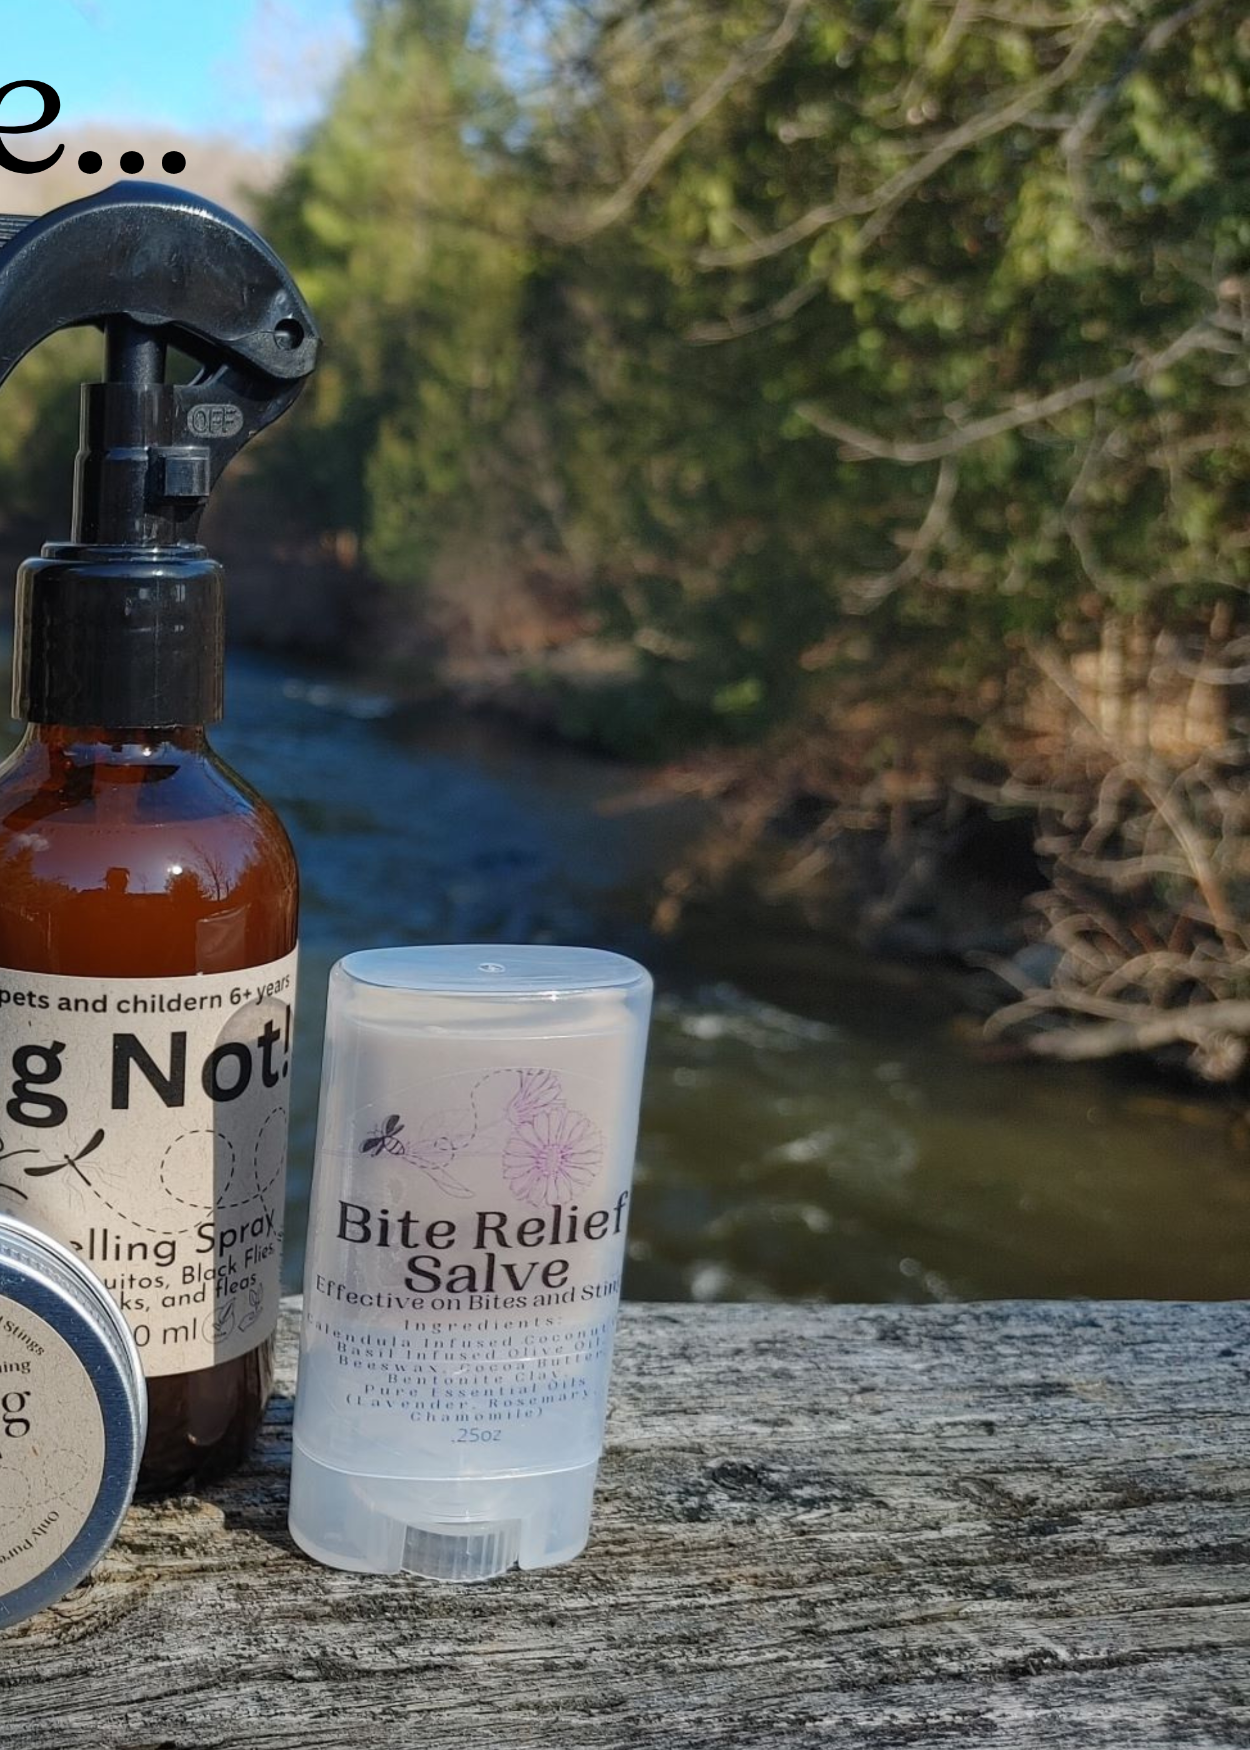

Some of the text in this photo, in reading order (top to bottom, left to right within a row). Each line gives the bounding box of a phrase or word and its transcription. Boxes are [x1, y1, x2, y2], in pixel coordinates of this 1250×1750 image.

[192, 406, 237, 434] OFF
[57, 994, 108, 1013] and
[116, 993, 222, 1014] childern
[230, 987, 252, 1005] 6+
[256, 974, 291, 1005] years
[111, 1004, 291, 1110] Not!
[196, 1208, 275, 1257] Spray
[337, 1190, 629, 1250] Bite Relief
[104, 1242, 274, 1291] uitos, Black Flies
[404, 1252, 570, 1294] Salve
[120, 1272, 256, 1313] ks, and fleas
[316, 1274, 424, 1310] Effective
[431, 1298, 461, 1310] on
[469, 1294, 527, 1311] Bites
[533, 1286, 575, 1307] and
[3, 1320, 45, 1356] Stings
[134, 1317, 197, 1347] 0 ml
[405, 1317, 562, 1334] Ingredients:
[451, 1428, 501, 1442] .25oz
[31, 1510, 60, 1542] Only
